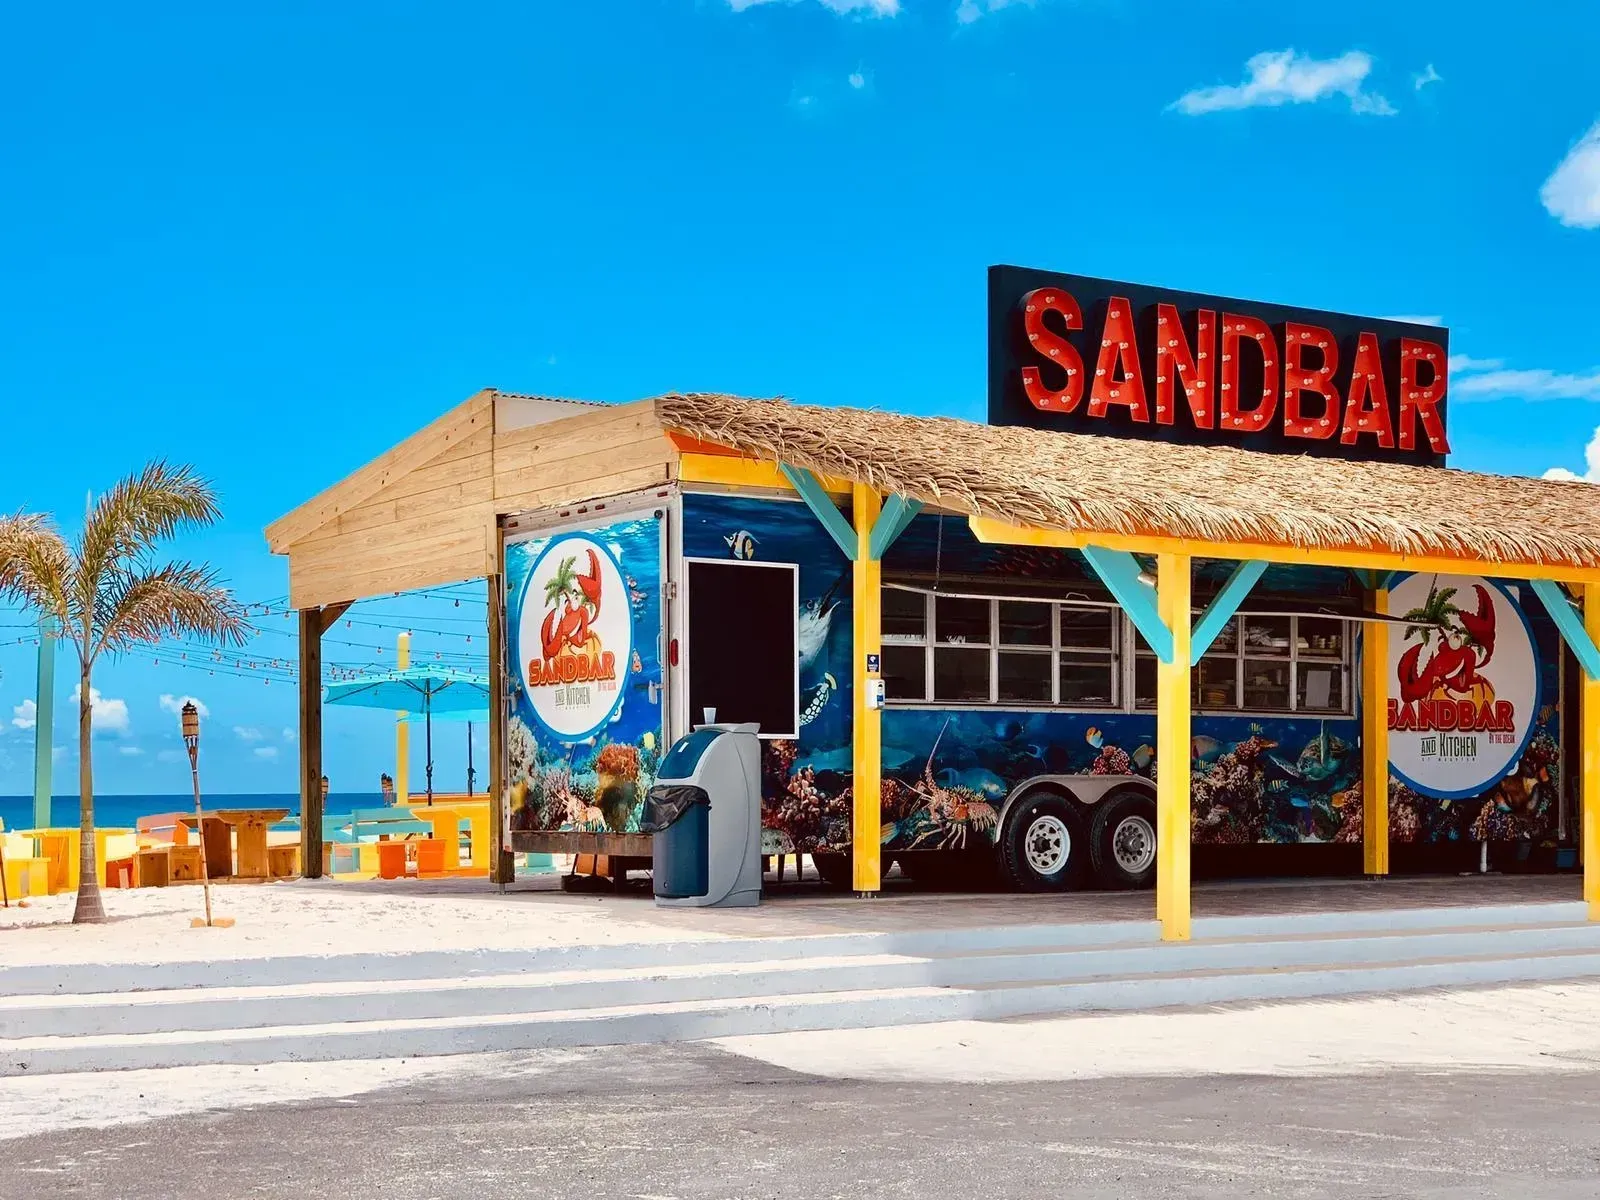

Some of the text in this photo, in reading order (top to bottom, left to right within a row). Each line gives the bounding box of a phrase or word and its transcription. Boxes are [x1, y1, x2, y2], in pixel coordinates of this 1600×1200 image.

[1020, 287, 1451, 454] SANDBAR
[529, 651, 616, 686] SANDBAR
[566, 685, 591, 705] KITCHEN
[1388, 698, 1514, 732] SANDBAR
[1421, 733, 1477, 756] AND KITCHEN
